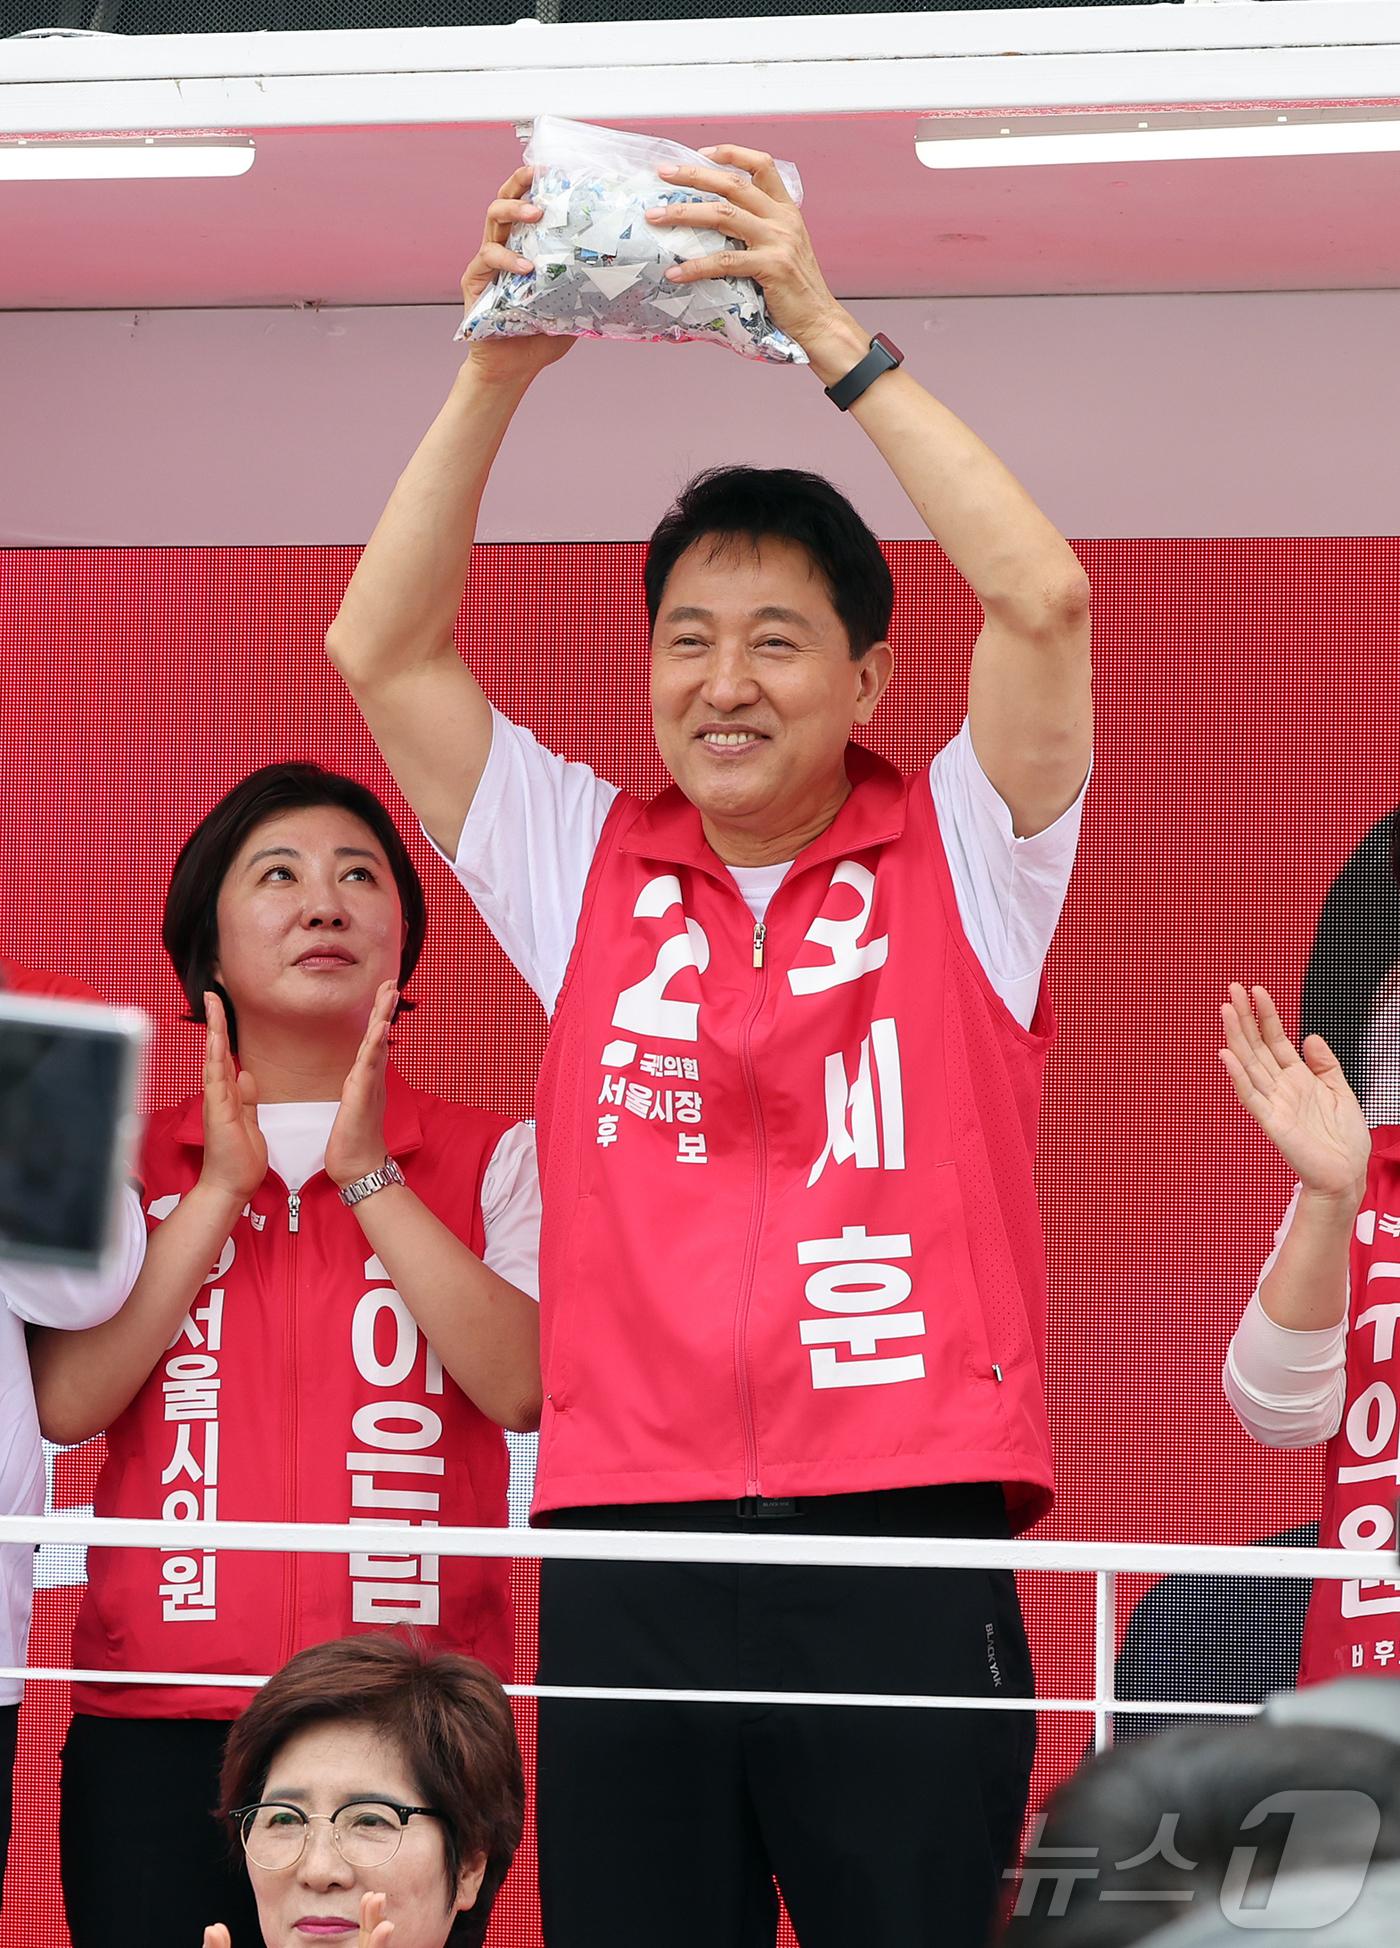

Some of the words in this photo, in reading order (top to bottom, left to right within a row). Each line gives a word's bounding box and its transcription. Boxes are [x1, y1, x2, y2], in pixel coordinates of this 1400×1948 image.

[611, 874, 710, 1042] 2
[597, 1074, 703, 1124] 서울시장
[787, 860, 926, 1390] 오세훈
